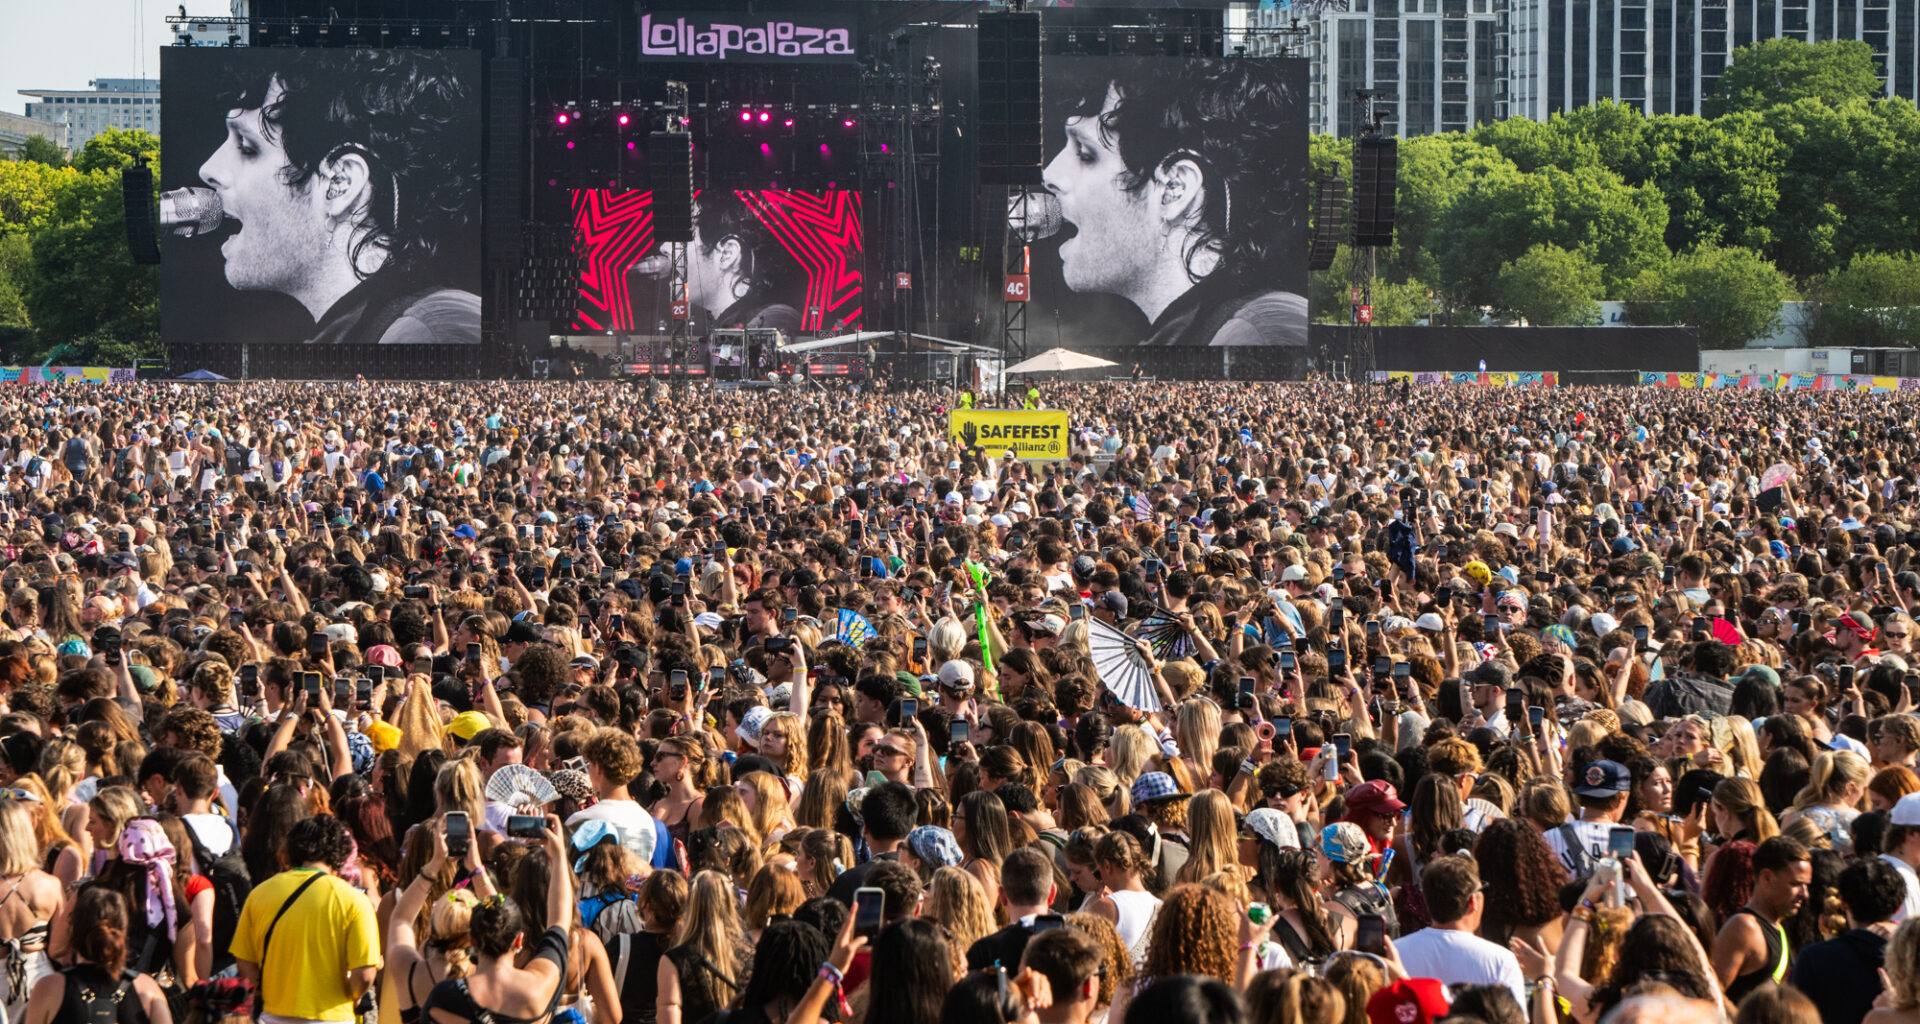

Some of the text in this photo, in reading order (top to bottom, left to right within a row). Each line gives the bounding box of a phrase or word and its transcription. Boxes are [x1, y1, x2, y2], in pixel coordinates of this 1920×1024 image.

[641, 14, 855, 60] Lollapalooza
[1007, 282, 1024, 295] 4C
[673, 305, 685, 315] 2C
[980, 424, 1061, 439] SAFEFEST
[1012, 442, 1046, 452] Allianz
